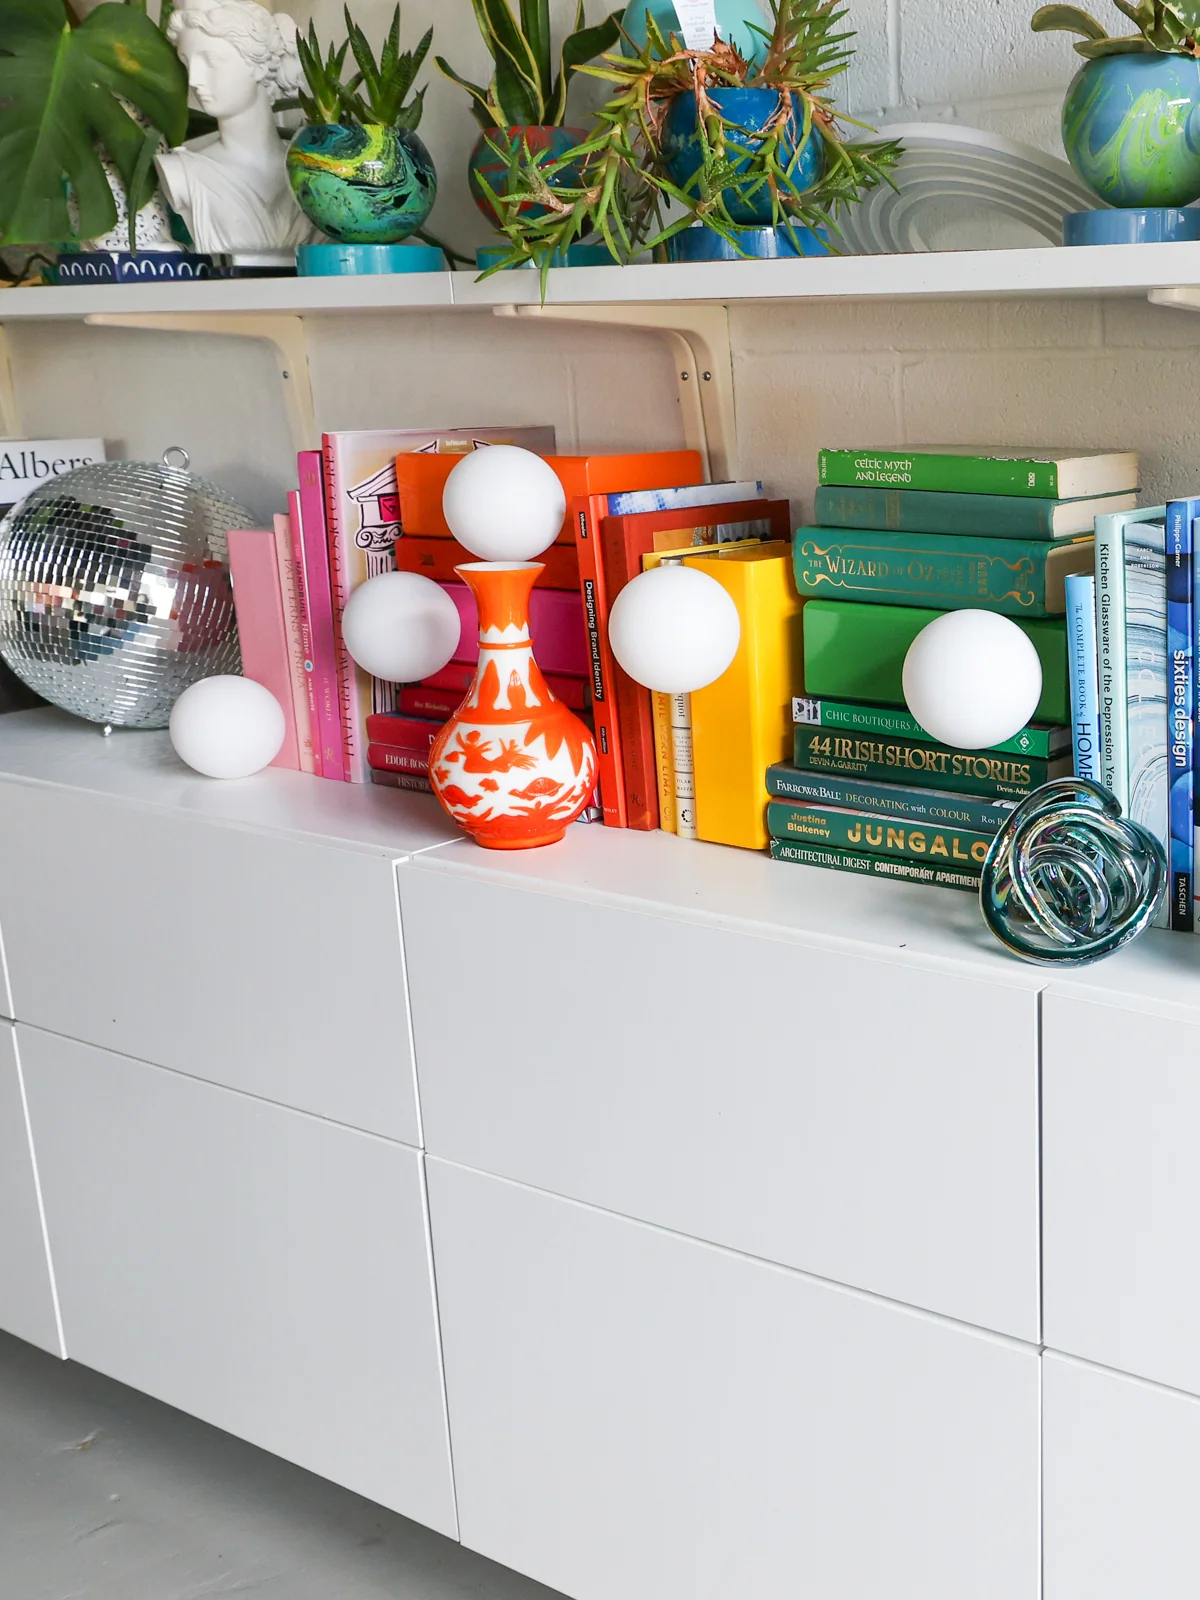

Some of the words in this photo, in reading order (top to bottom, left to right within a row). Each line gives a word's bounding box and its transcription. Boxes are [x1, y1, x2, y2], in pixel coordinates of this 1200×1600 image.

[324, 445, 337, 511] GRECO
[579, 511, 587, 538] Wheeler
[1173, 514, 1181, 543] Philippe
[328, 517, 341, 572] DISCO
[808, 560, 822, 568] THE
[825, 556, 889, 578] WIZARD
[907, 561, 933, 581] OZ
[1099, 543, 1110, 589] Kitchen
[585, 581, 595, 629] Designing
[284, 558, 299, 633] PATTERNS
[294, 649, 307, 689] INDIA
[301, 623, 310, 655] Home
[1101, 594, 1111, 654] Glassware
[590, 631, 600, 660] Brand
[1075, 617, 1085, 676] COMPLETE
[1102, 658, 1112, 670] of
[1173, 649, 1189, 706] sixties
[593, 662, 603, 699] Identity
[1077, 679, 1087, 710] BOOK
[1103, 673, 1112, 693] the
[657, 692, 667, 719] MIE
[826, 710, 850, 721] CHIC
[852, 714, 911, 731] BOUTIQUERS
[1102, 697, 1115, 761] Depression
[1172, 707, 1190, 768] design
[385, 754, 409, 768] EDDIE
[808, 735, 831, 757] 44
[833, 738, 885, 766] IRISH
[886, 746, 950, 775] SHORT
[952, 754, 1032, 786] STORIES
[809, 757, 830, 766] DEVIN
[838, 761, 868, 772] GARRITY
[1077, 722, 1093, 779] HOME
[661, 765, 673, 797] LIMA
[1105, 766, 1115, 791] Year
[791, 813, 827, 825] Justina
[845, 793, 909, 811] DECORATING
[911, 804, 927, 814] with
[929, 807, 972, 822] COLOUR
[981, 815, 996, 825] Ros
[787, 823, 831, 838] Blakeney
[847, 823, 989, 863] JUNGALO
[780, 847, 842, 867] ARCHITECTURAL
[842, 857, 871, 871] DIGEST
[874, 861, 934, 881] CONTEMPORARY
[935, 872, 982, 889] APARTMENT
[1178, 877, 1186, 916] TASCHEN
